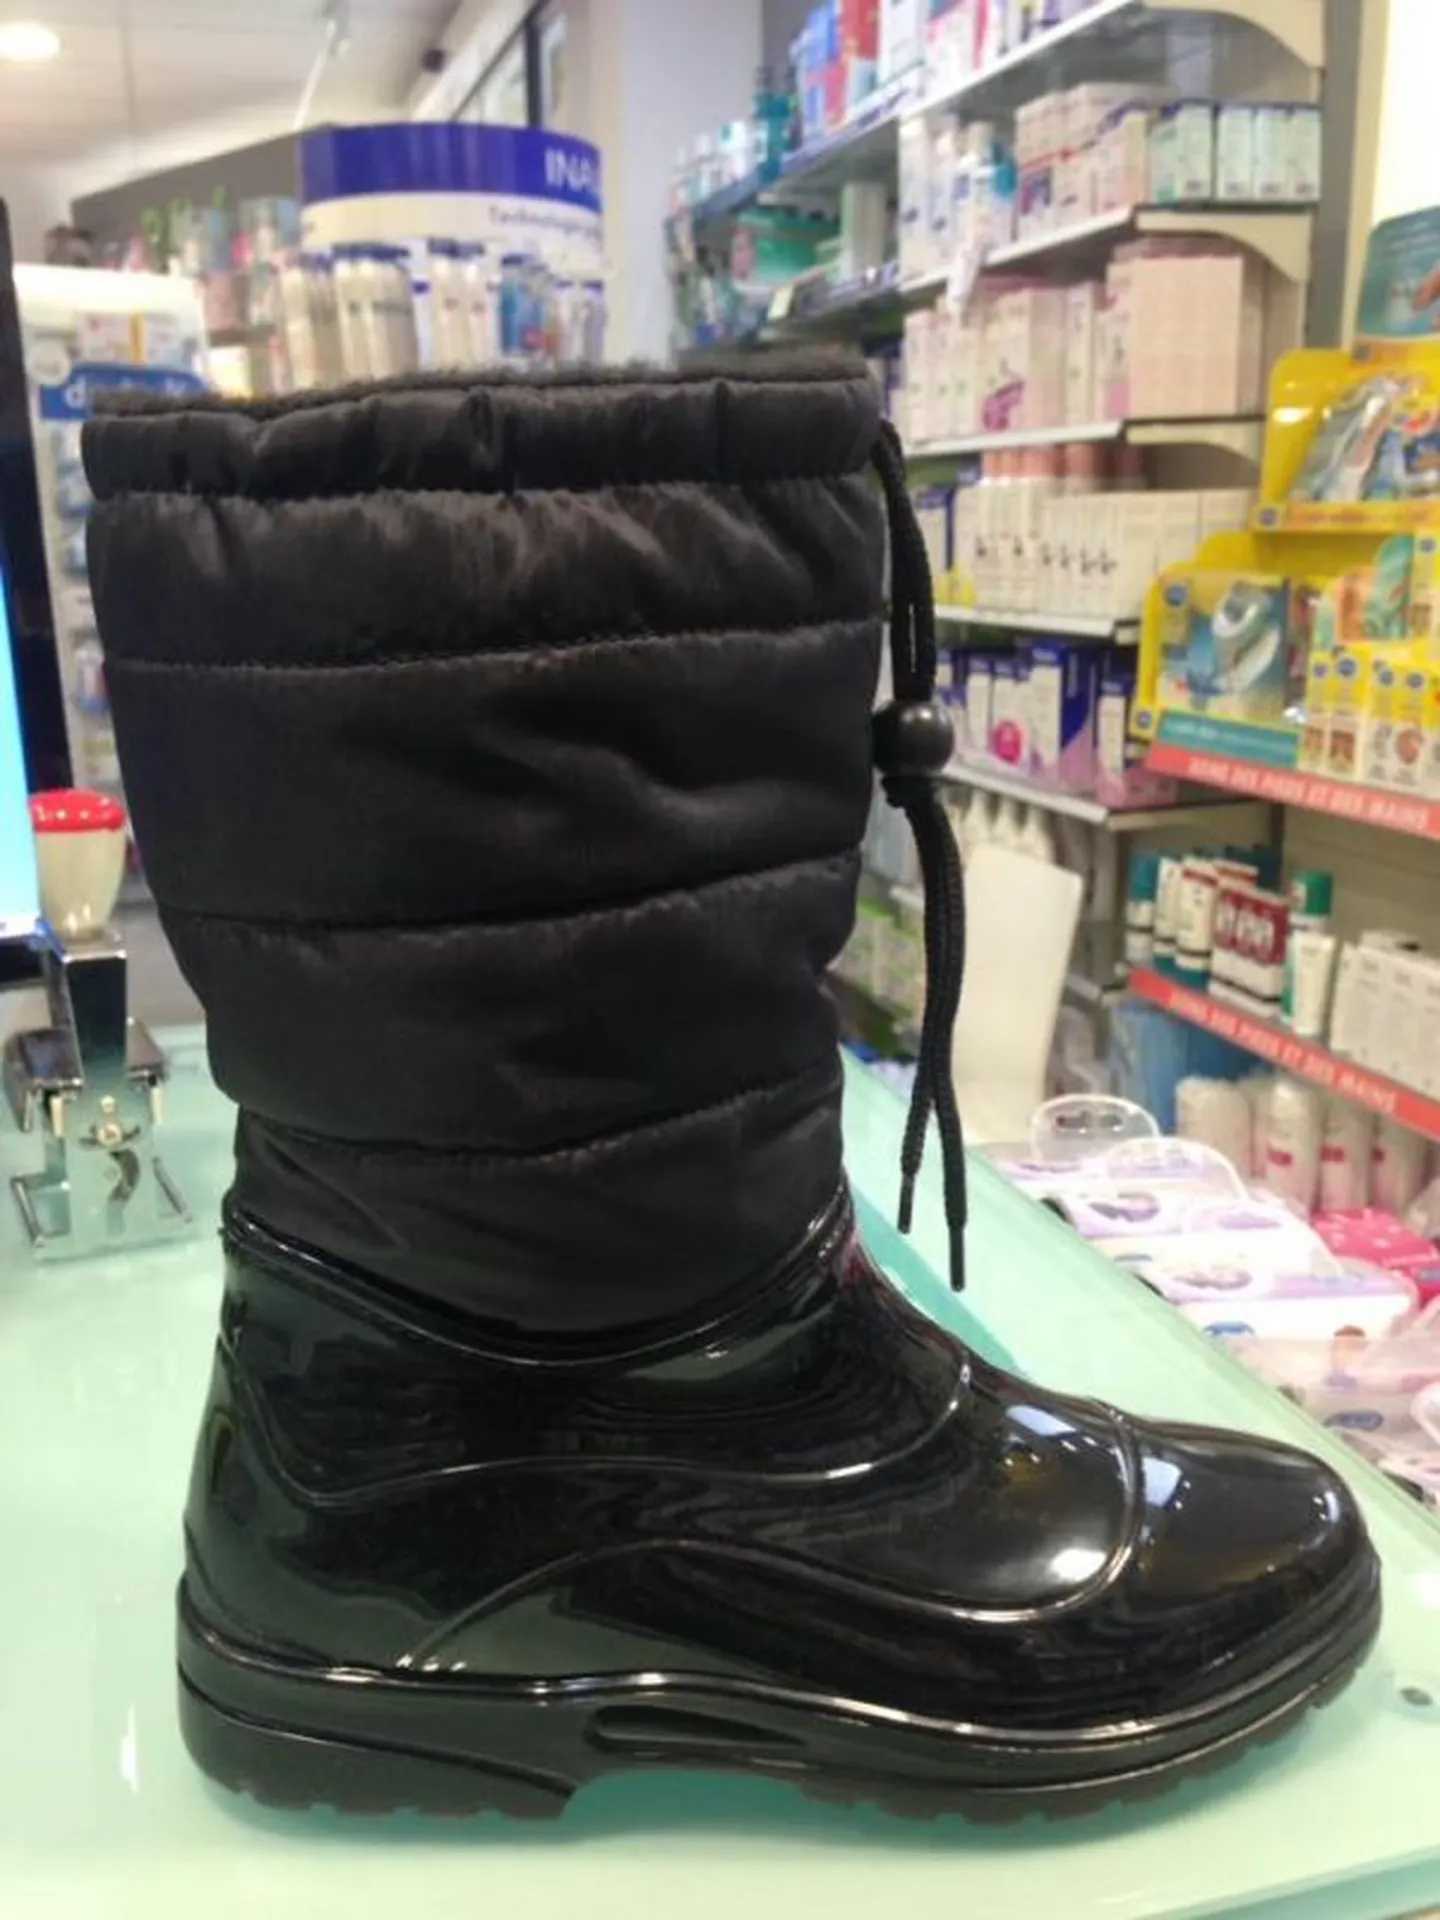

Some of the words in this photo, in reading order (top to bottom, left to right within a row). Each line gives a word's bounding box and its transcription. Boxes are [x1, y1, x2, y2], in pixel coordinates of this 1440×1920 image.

[1231, 763, 1259, 789] DES
[1308, 781, 1328, 805] ET
[1330, 785, 1364, 813] DES
[1369, 798, 1429, 829] MAINS
[1339, 1071, 1396, 1111] MAINS
